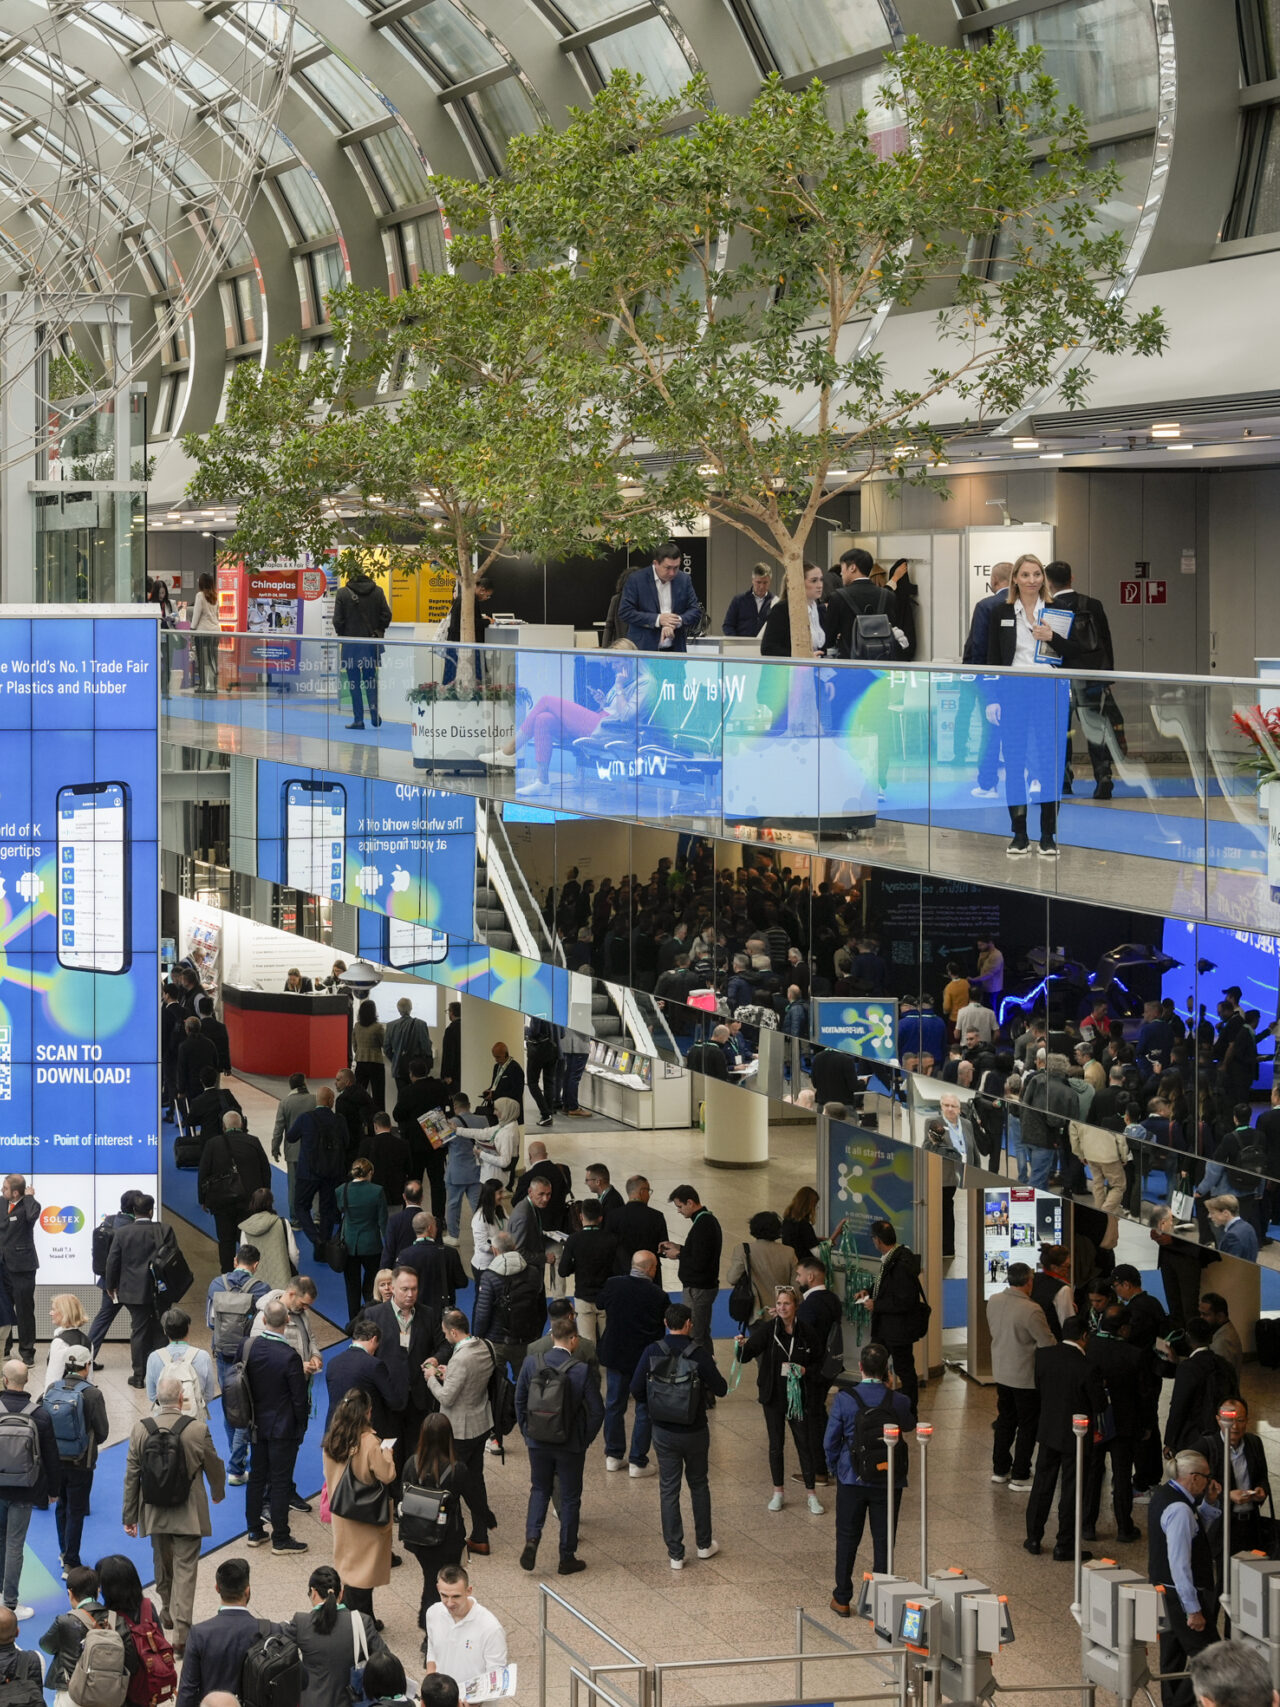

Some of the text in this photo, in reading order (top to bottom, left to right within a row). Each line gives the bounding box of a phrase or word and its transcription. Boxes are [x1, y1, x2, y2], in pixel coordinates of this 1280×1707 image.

[251, 580, 296, 591] Chinaplas
[11, 660, 56, 673] World's
[59, 660, 78, 673] No.
[81, 660, 86, 673] 1
[89, 660, 123, 673] Trade
[126, 660, 149, 673] Fair
[7, 681, 54, 694] Plastics
[57, 681, 80, 694] and
[83, 681, 127, 694] Rubber
[418, 725, 514, 738] Messe Düsseldorf
[18, 823, 30, 837] of
[33, 824, 42, 837] K
[36, 1045, 102, 1061] SCAN TO
[37, 1068, 131, 1084] DOWNLOAD!
[53, 1134, 79, 1146] Point
[81, 1134, 92, 1146] of
[95, 1134, 133, 1146] interest
